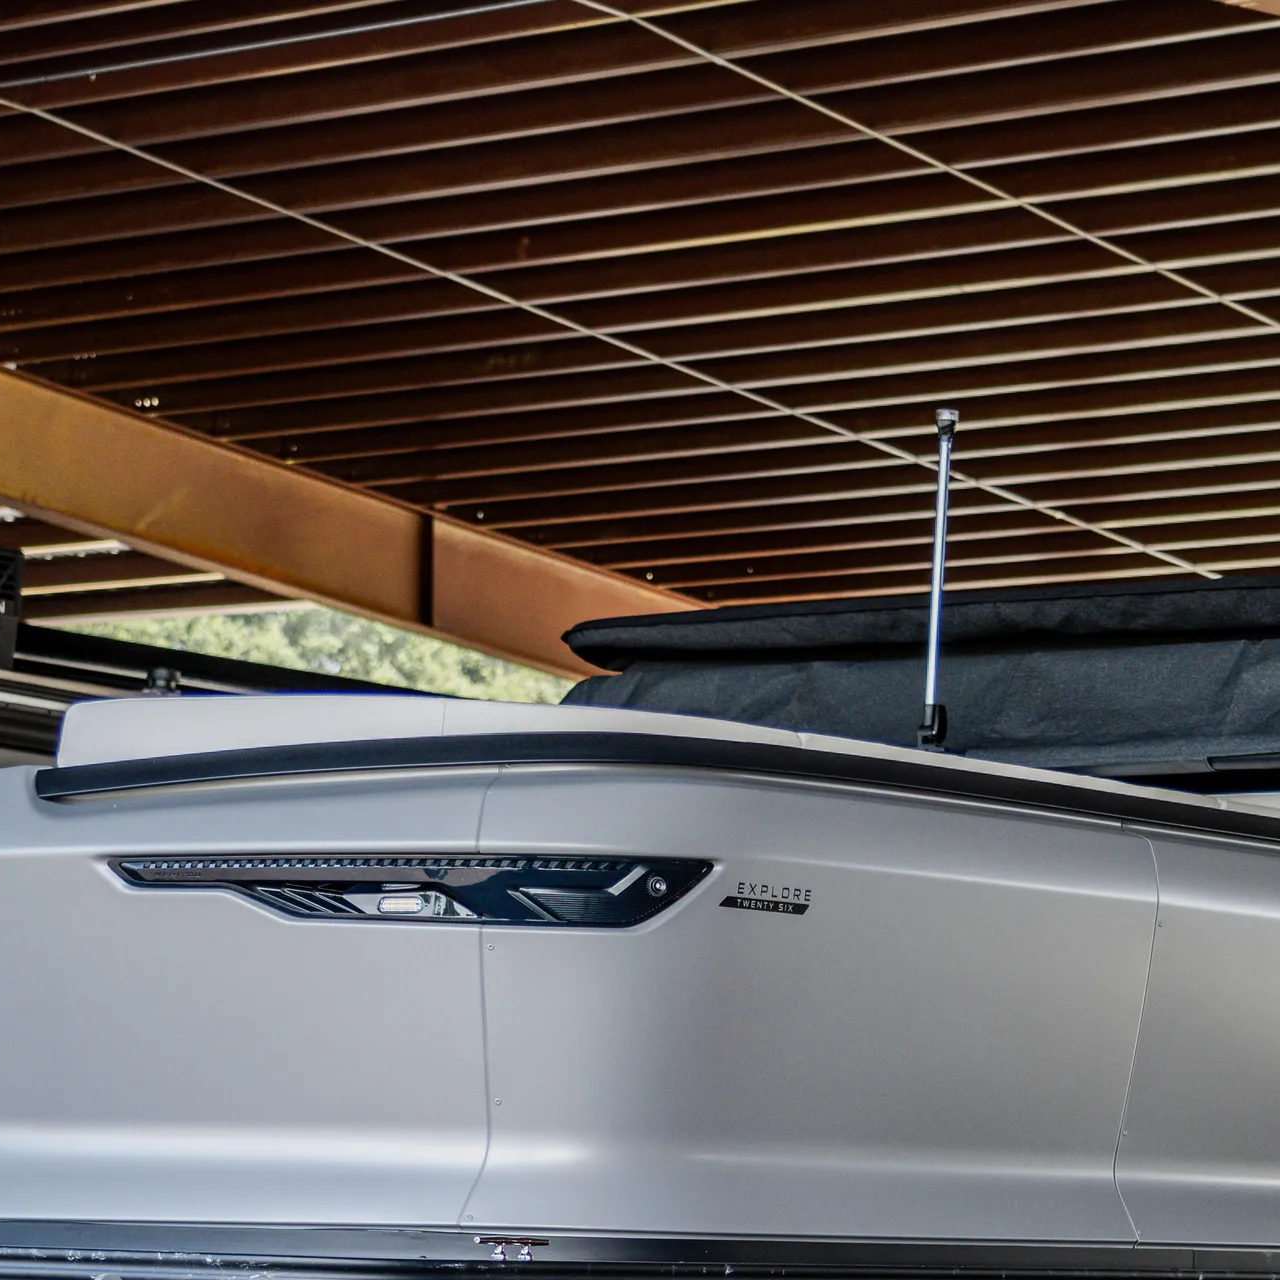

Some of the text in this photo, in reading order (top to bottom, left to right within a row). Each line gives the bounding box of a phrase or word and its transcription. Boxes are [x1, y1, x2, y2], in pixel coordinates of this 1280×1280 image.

[737, 882, 812, 901] EXPLORE
[736, 899, 794, 912] TWENTY SIX
